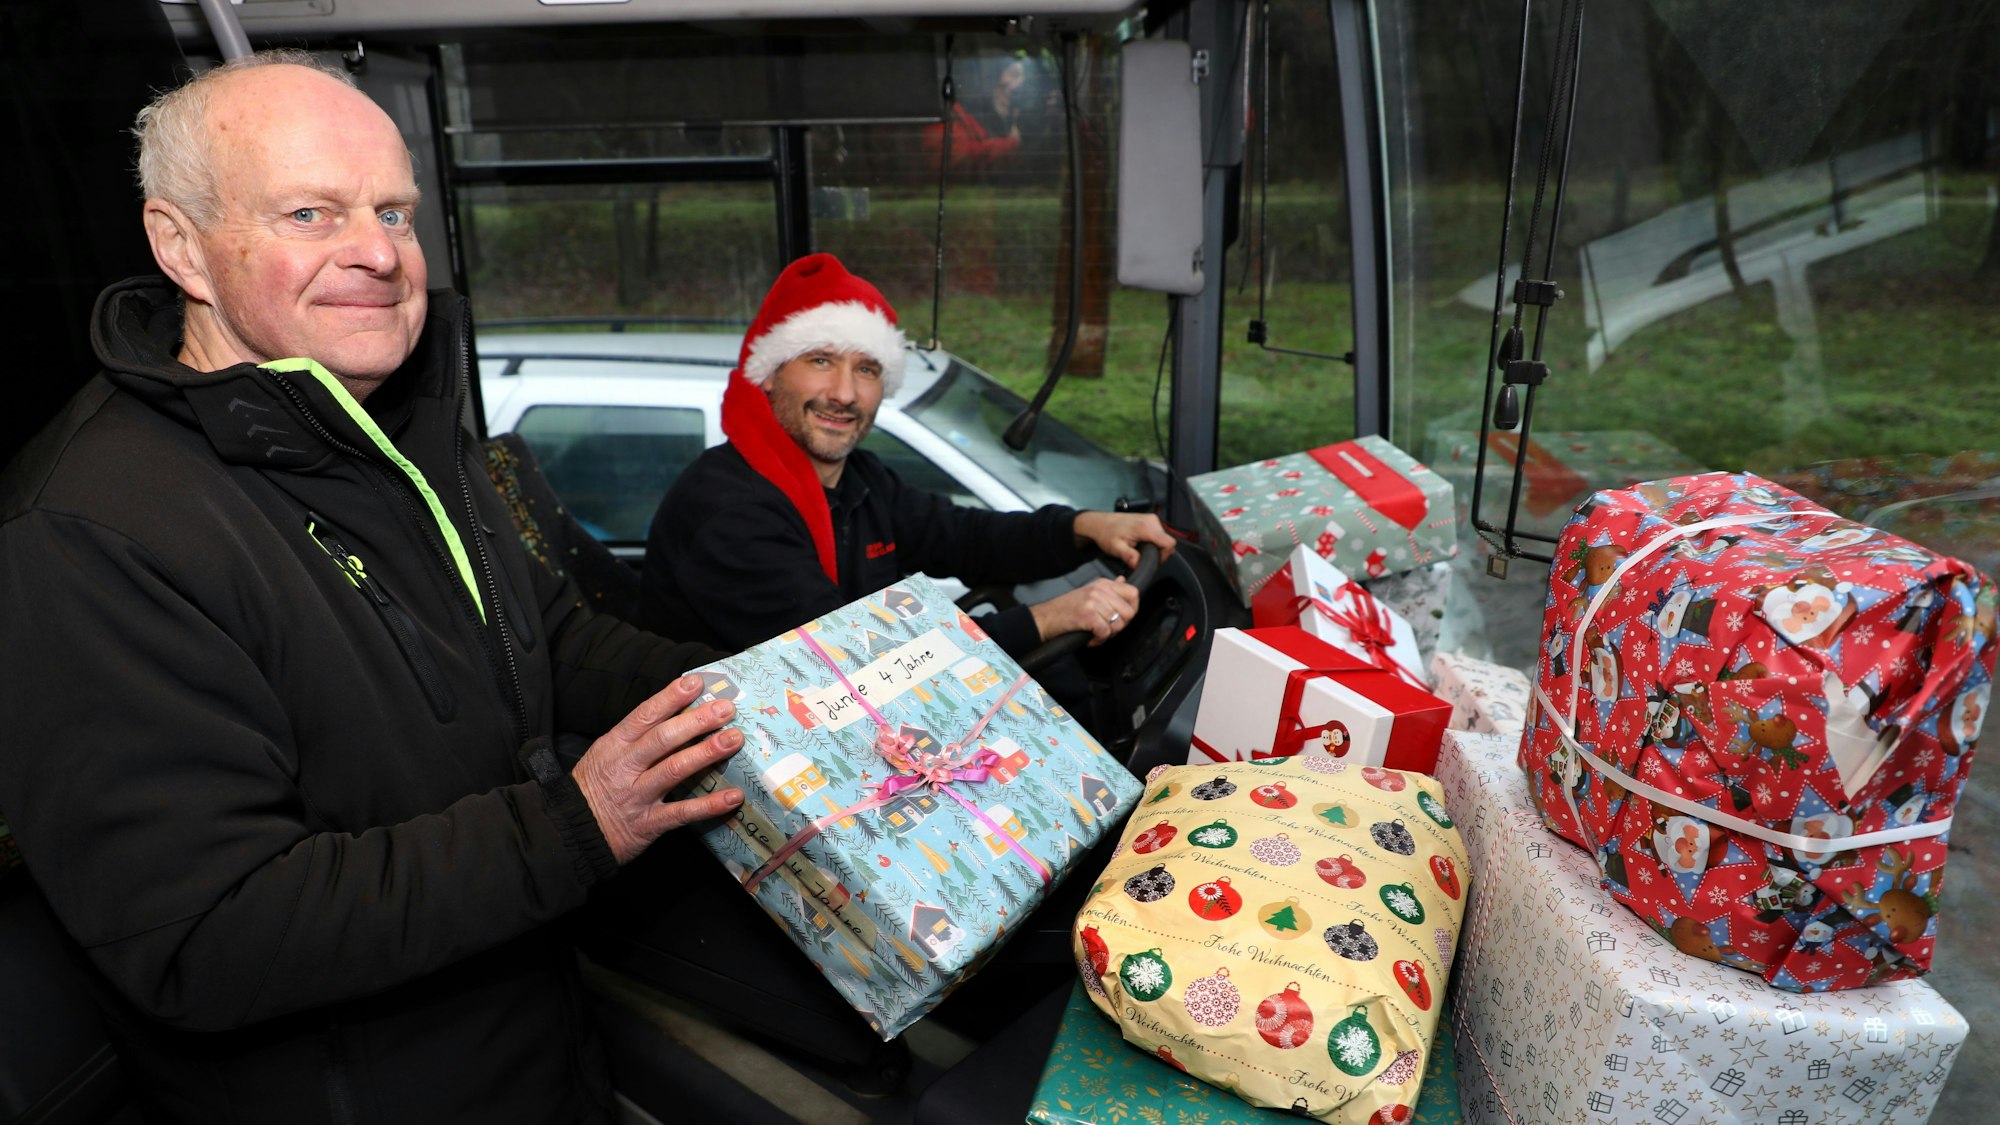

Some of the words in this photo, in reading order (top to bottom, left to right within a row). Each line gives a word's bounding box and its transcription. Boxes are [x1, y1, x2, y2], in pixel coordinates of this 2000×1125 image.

[878, 671, 894, 684] 4
[894, 650, 934, 680] Jahre
[1265, 814, 1299, 829] Frohe
[1304, 825, 1377, 860] Weihnachten
[1191, 851, 1268, 882] Weihnachten
[791, 861, 803, 876] 4
[812, 881, 862, 934] Jahre
[1346, 901, 1384, 923] Frohe
[1203, 934, 1242, 957] Frohe
[1247, 945, 1331, 982] Weihnachten
[1125, 1006, 1205, 1052] Weihnachten
[1288, 1069, 1330, 1095] Frohe
